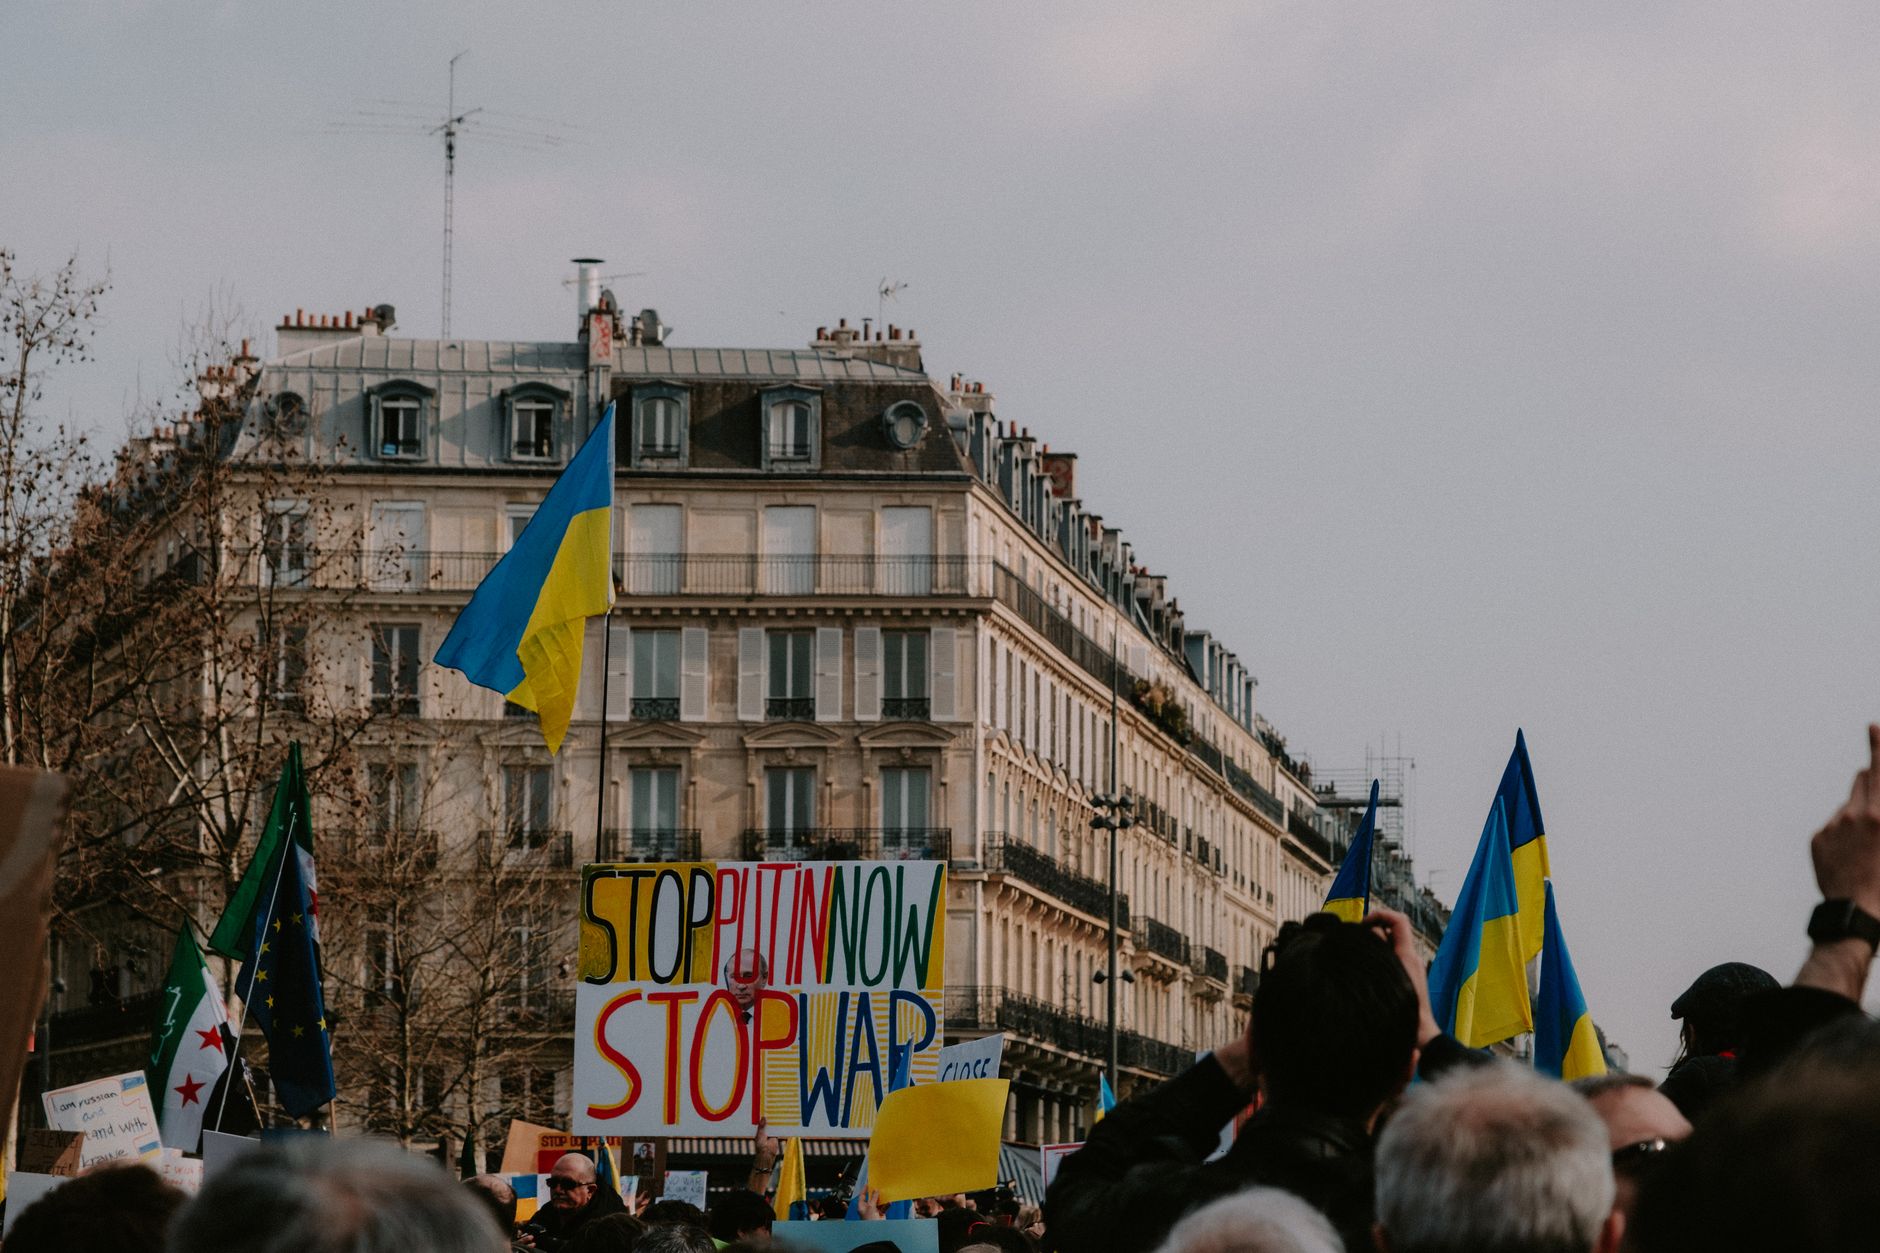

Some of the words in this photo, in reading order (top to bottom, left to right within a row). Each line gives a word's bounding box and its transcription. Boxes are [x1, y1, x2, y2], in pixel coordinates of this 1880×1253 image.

[585, 867, 715, 985] STOP
[825, 864, 944, 990] NOW
[586, 989, 799, 1126] STOP
[799, 990, 937, 1129] WAR
[59, 1102, 76, 1112] am
[78, 1091, 120, 1110] russian
[82, 1107, 105, 1122] and
[85, 1122, 115, 1141] tand
[541, 1135, 567, 1147] STOP
